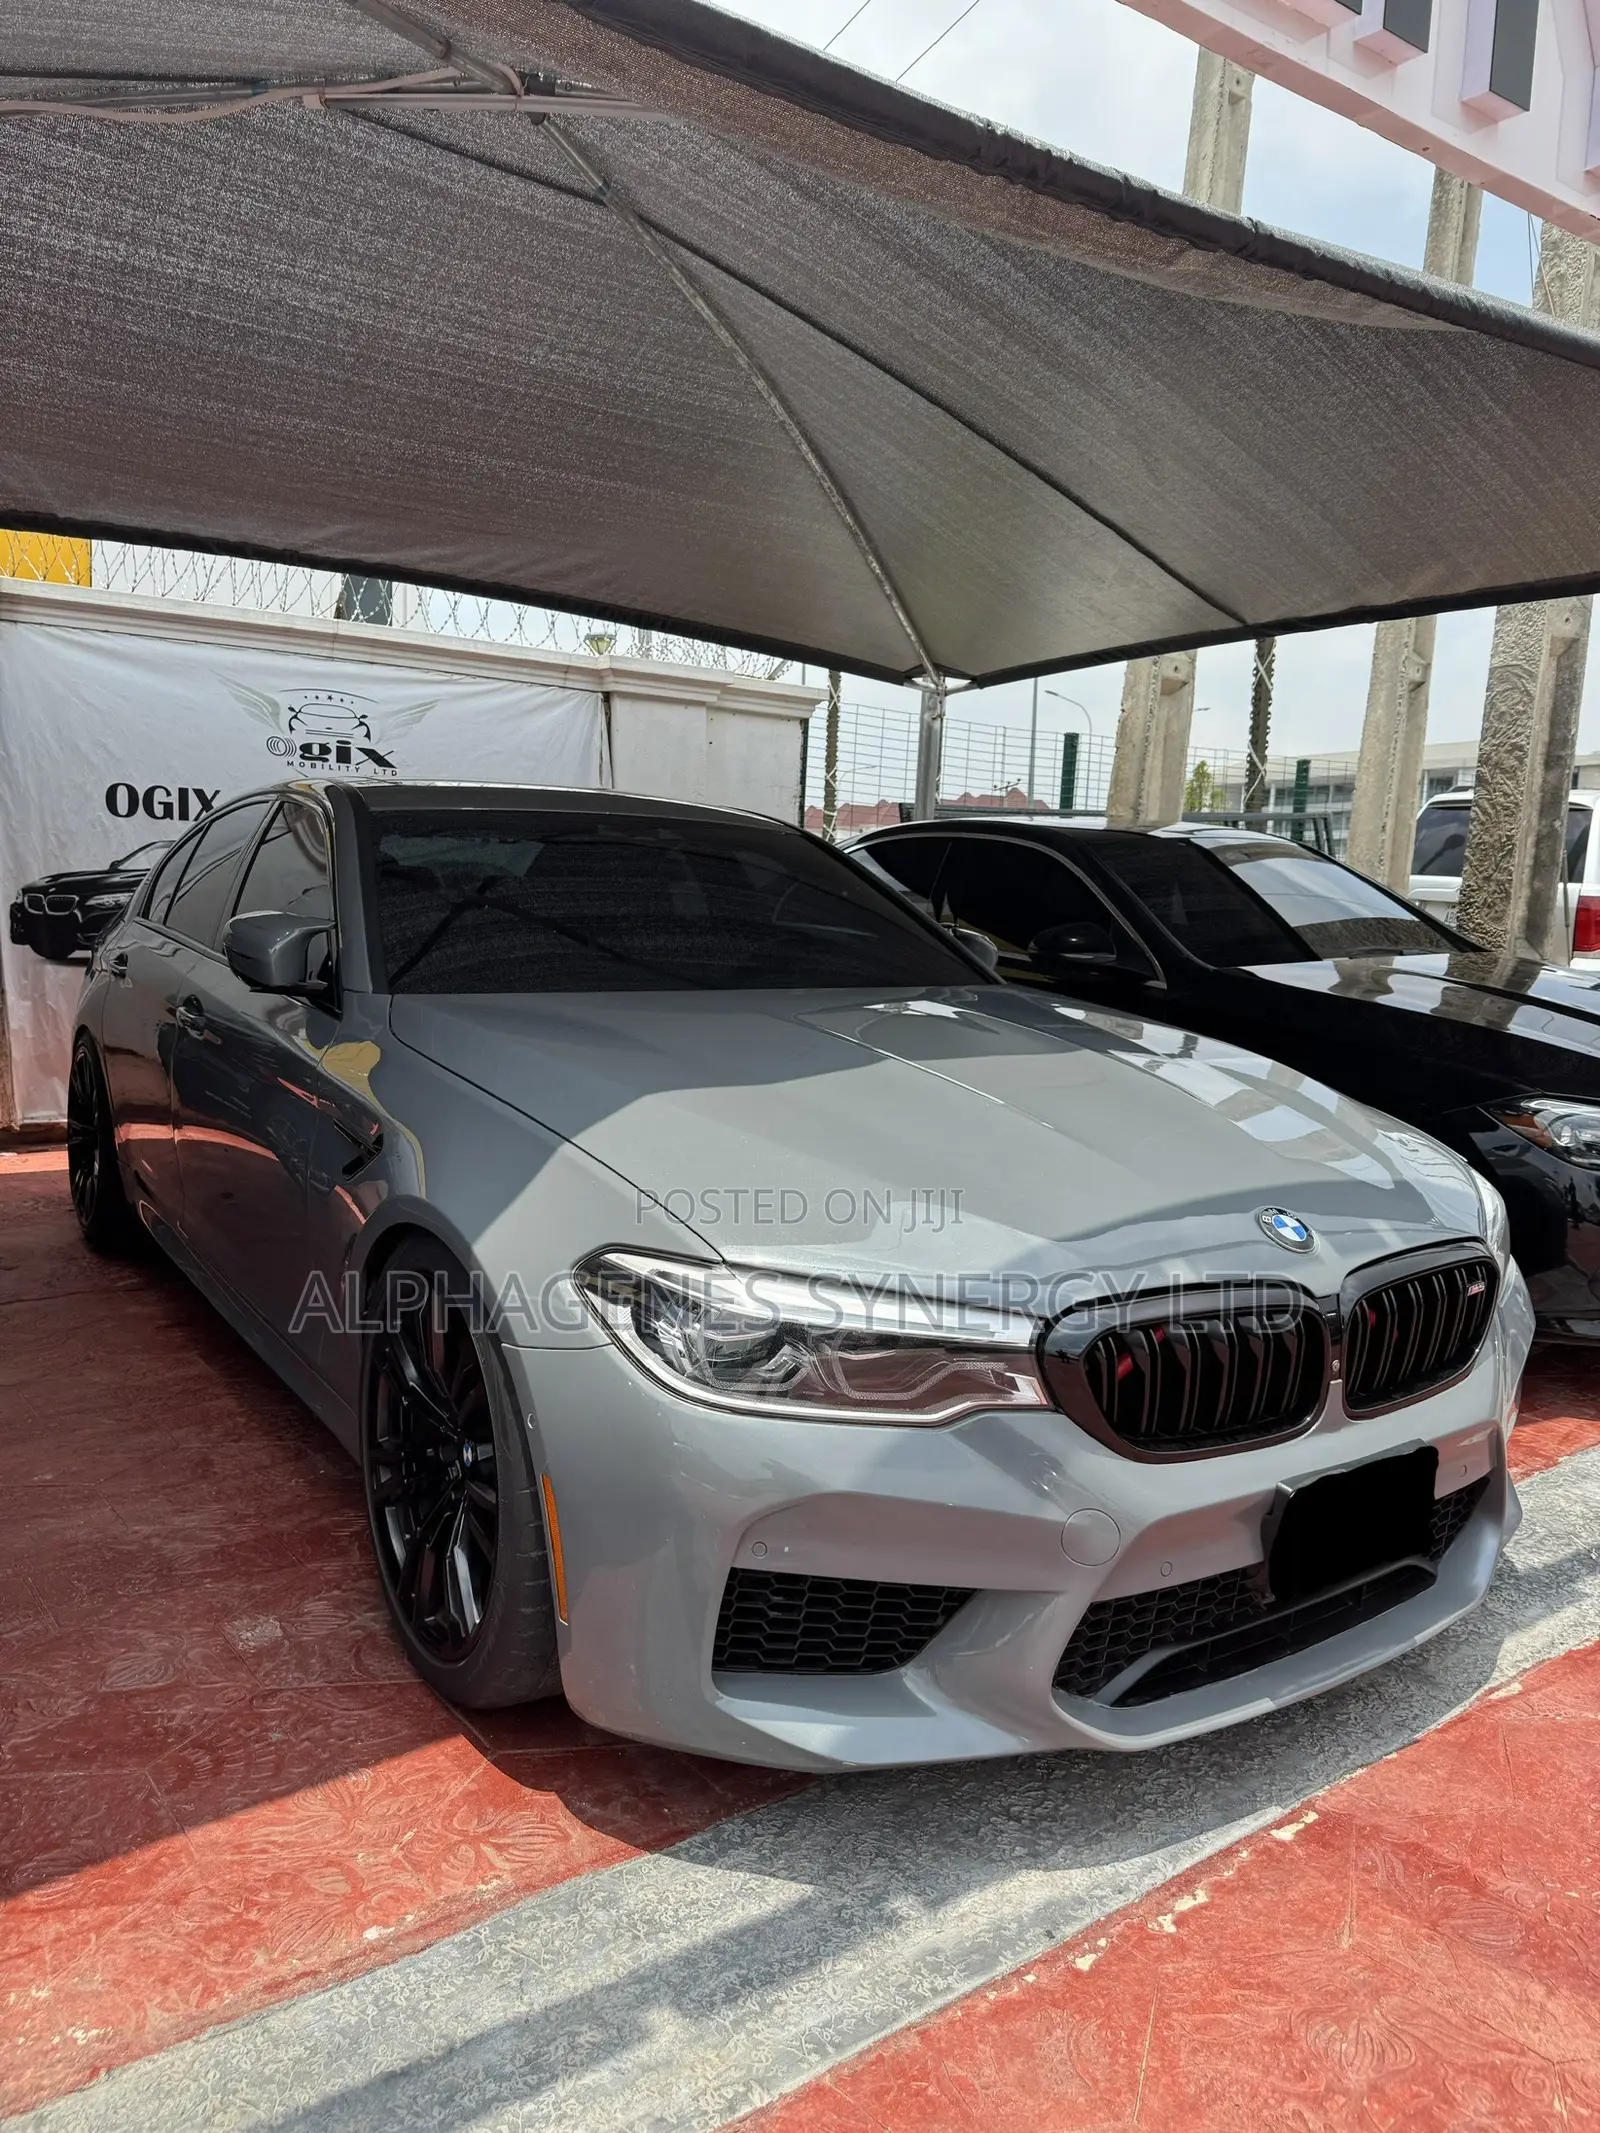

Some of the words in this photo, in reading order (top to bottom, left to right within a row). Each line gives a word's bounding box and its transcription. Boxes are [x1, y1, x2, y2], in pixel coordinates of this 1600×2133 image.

[286, 760, 361, 773] MOBILITY
[373, 768, 398, 777] LTD
[105, 782, 221, 821] OGIX
